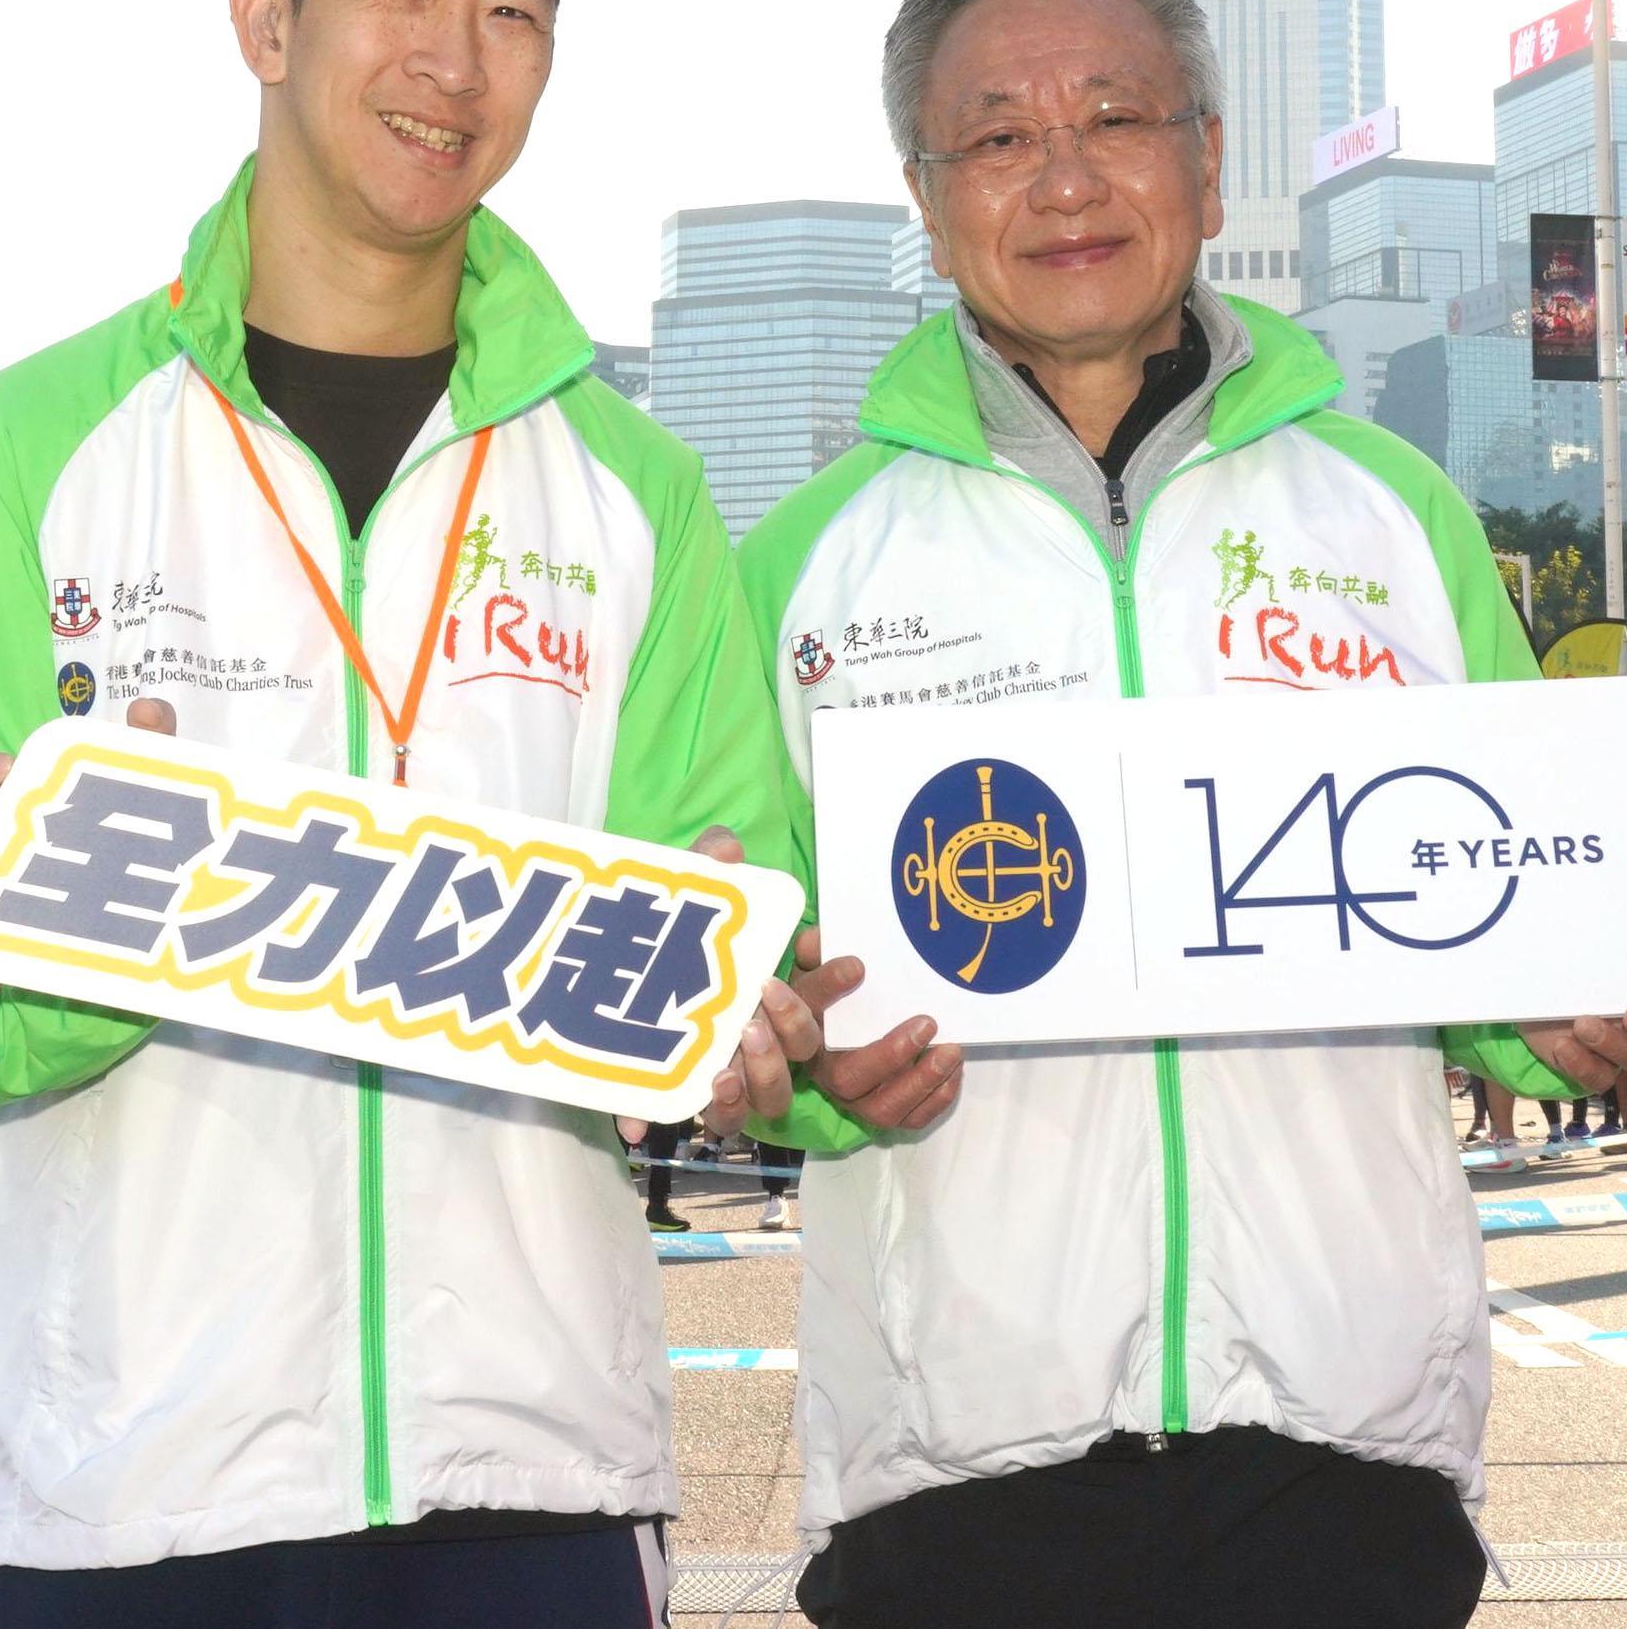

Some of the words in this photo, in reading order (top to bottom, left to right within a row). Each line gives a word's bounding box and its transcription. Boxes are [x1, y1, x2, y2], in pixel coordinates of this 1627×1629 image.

[1332, 123, 1376, 168] LIVING
[1288, 565, 1390, 608] 奔向共融
[124, 615, 148, 630] Wah
[158, 603, 170, 614] of
[844, 655, 869, 669] Tung
[870, 650, 893, 662] Wah
[893, 645, 926, 659] Group
[926, 642, 939, 654] of
[937, 631, 983, 652] Hospitals
[122, 683, 140, 698] Ho
[199, 674, 223, 691] Club
[225, 675, 280, 692] Charities
[283, 674, 313, 689] Trust
[976, 688, 1002, 706] Club
[1003, 678, 1058, 697] Charities
[1058, 671, 1090, 687] Trust
[1410, 838, 1450, 877] 年
[1458, 834, 1606, 869] YEARS
